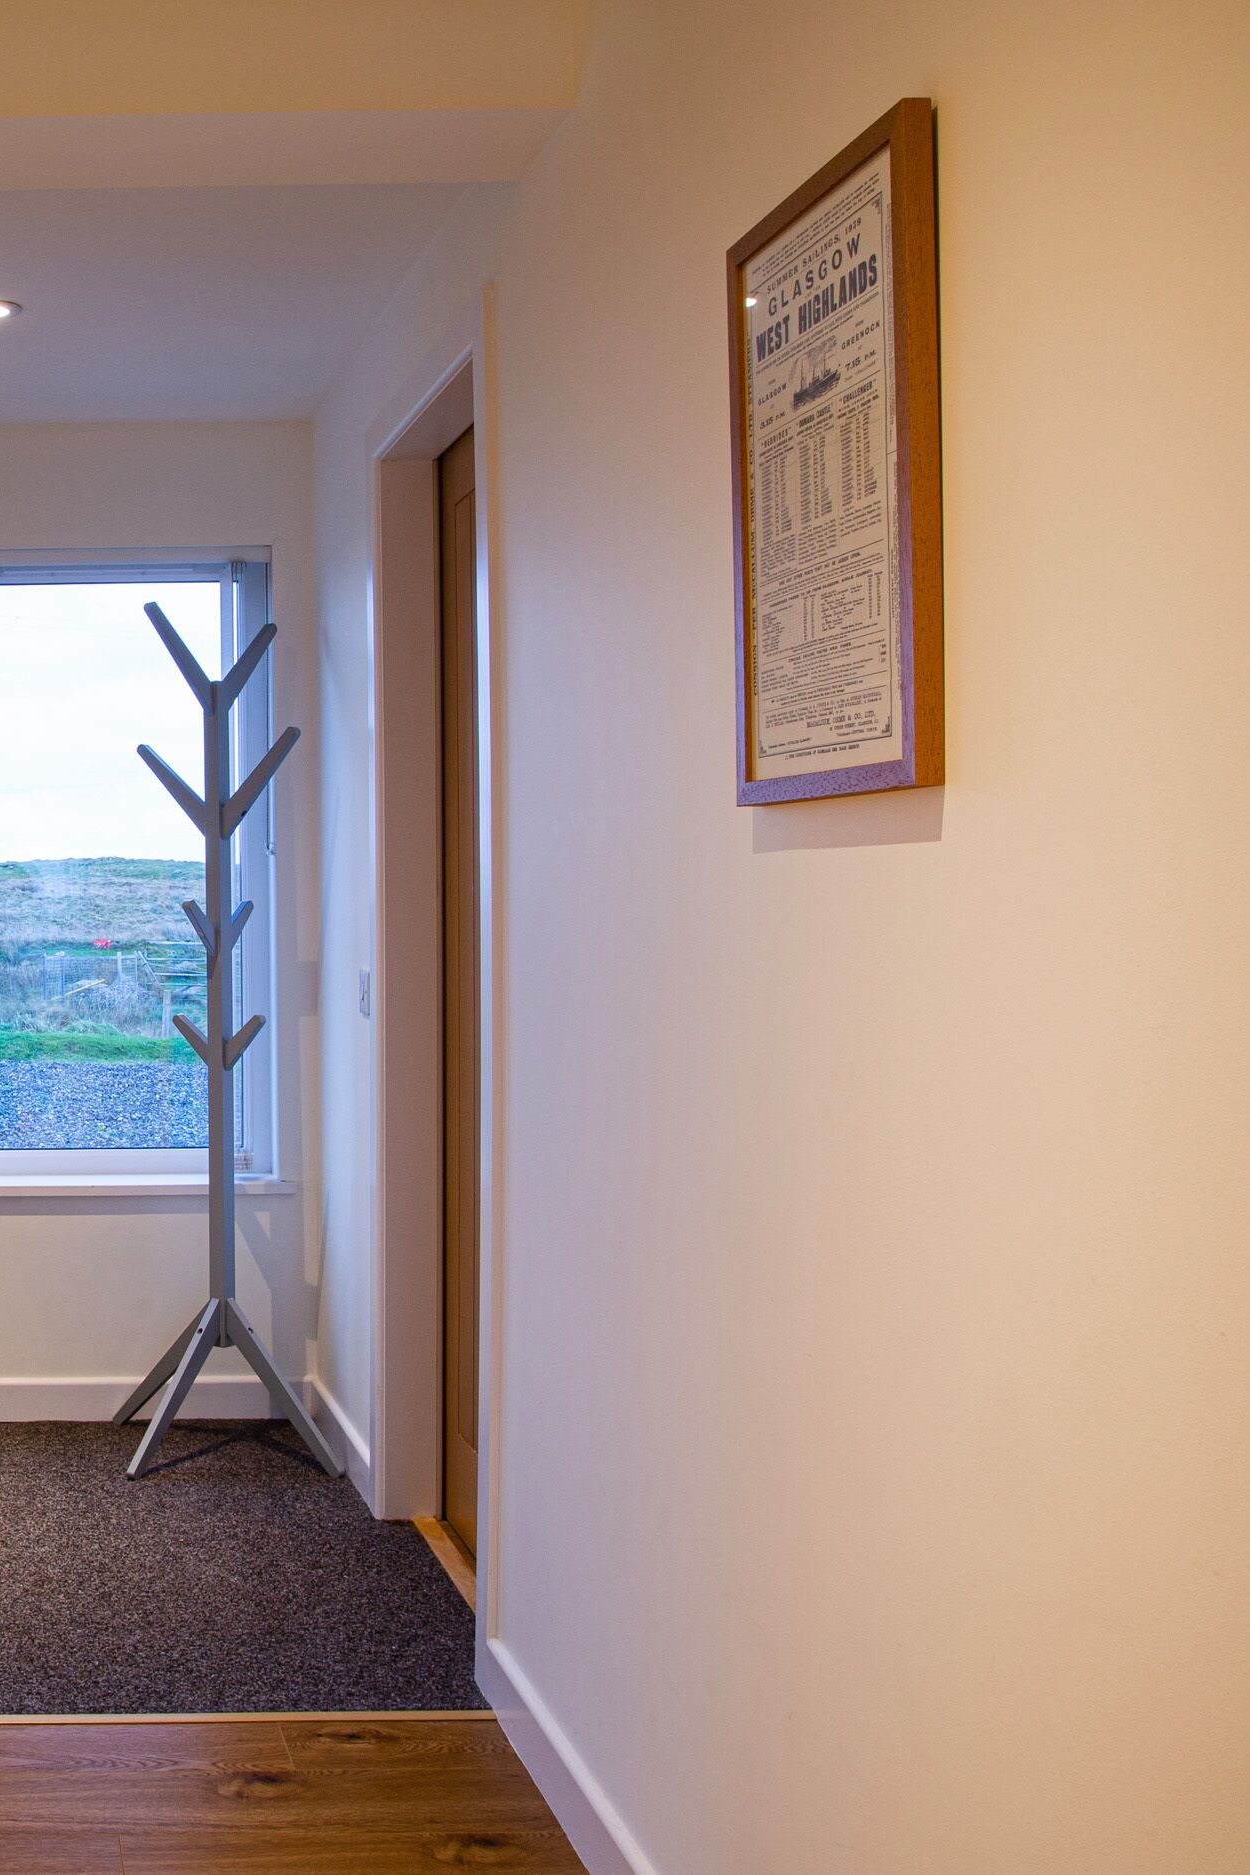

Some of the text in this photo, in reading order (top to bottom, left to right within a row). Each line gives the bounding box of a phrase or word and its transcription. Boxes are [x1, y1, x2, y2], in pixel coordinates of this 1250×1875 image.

[766, 264, 798, 294] SUMMER
[768, 233, 861, 316] GLASGOW
[756, 314, 790, 363] WEST
[798, 253, 878, 335] HIGHLANDS
[841, 320, 880, 350] GREENOCK
[758, 384, 786, 406] GLASGOW
